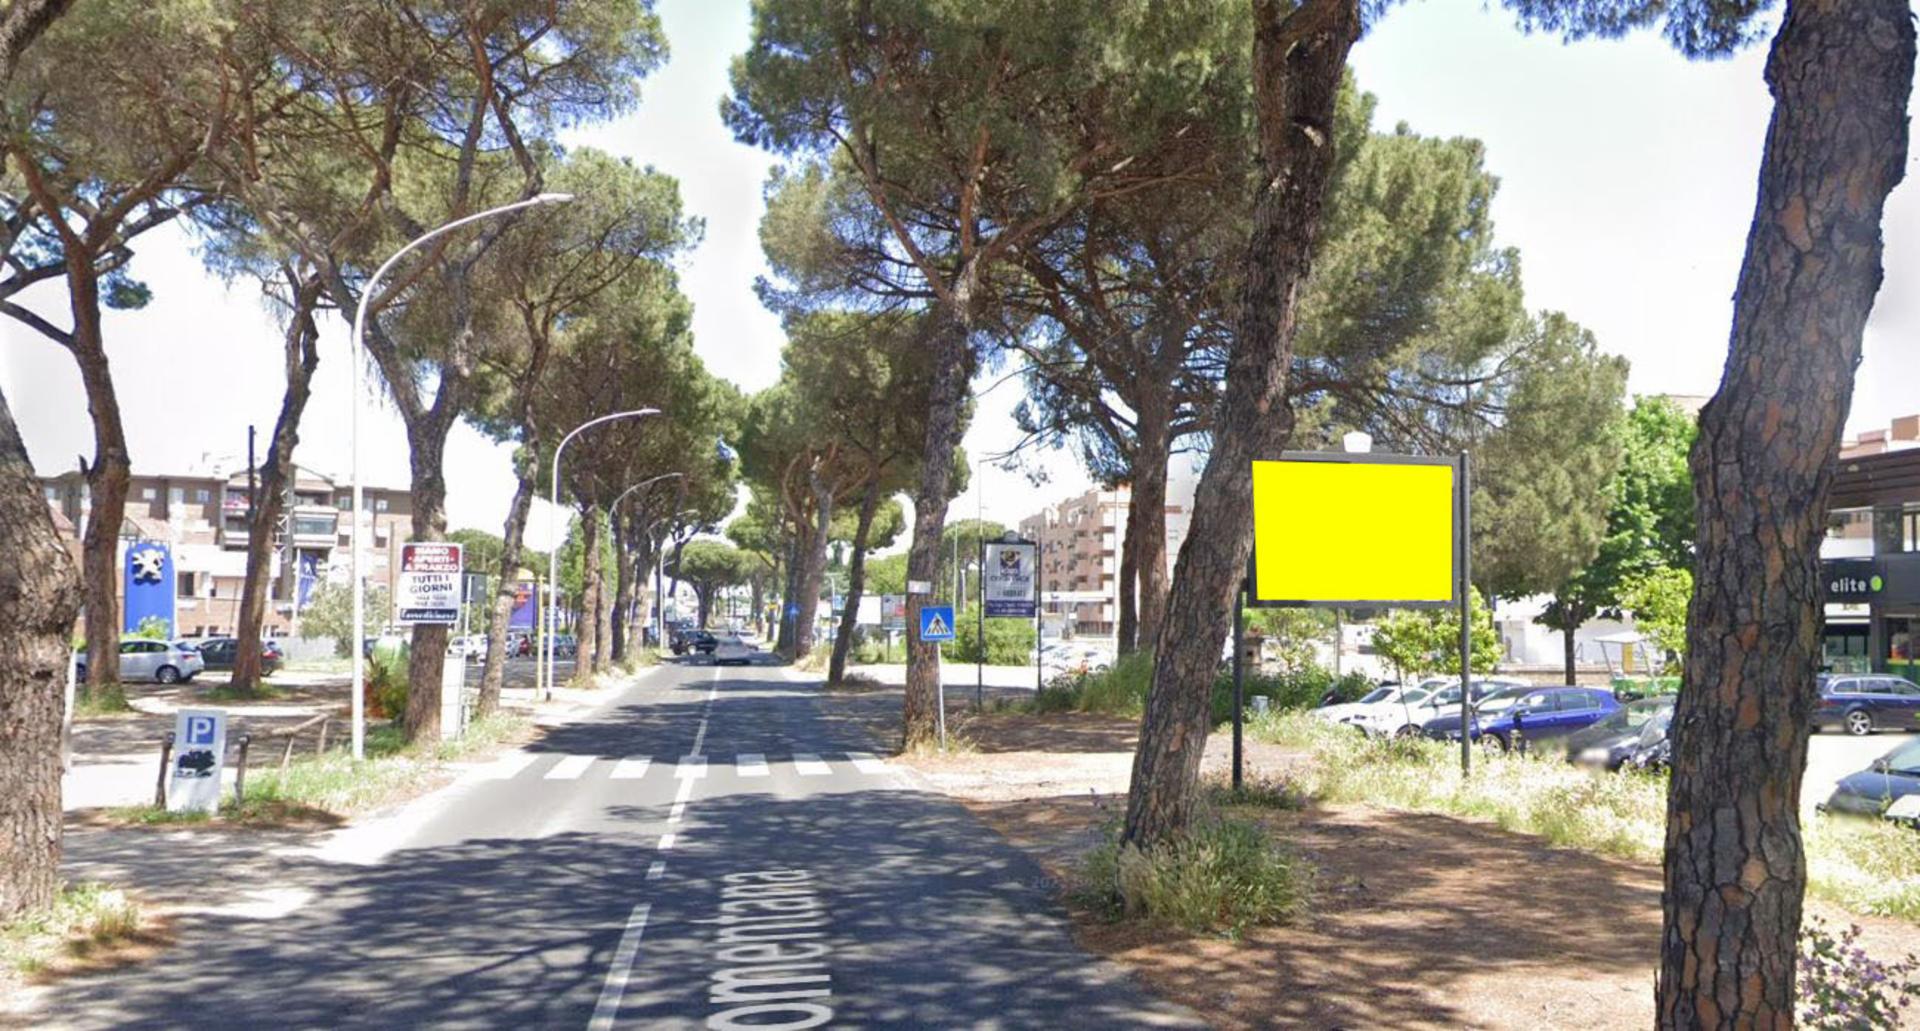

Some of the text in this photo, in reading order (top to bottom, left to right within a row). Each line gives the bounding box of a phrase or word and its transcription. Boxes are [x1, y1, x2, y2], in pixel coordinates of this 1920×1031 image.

[412, 574, 443, 583] TUTTI
[1831, 577, 1867, 592] elite
[410, 583, 452, 593] GIORNI
[191, 718, 212, 743] P
